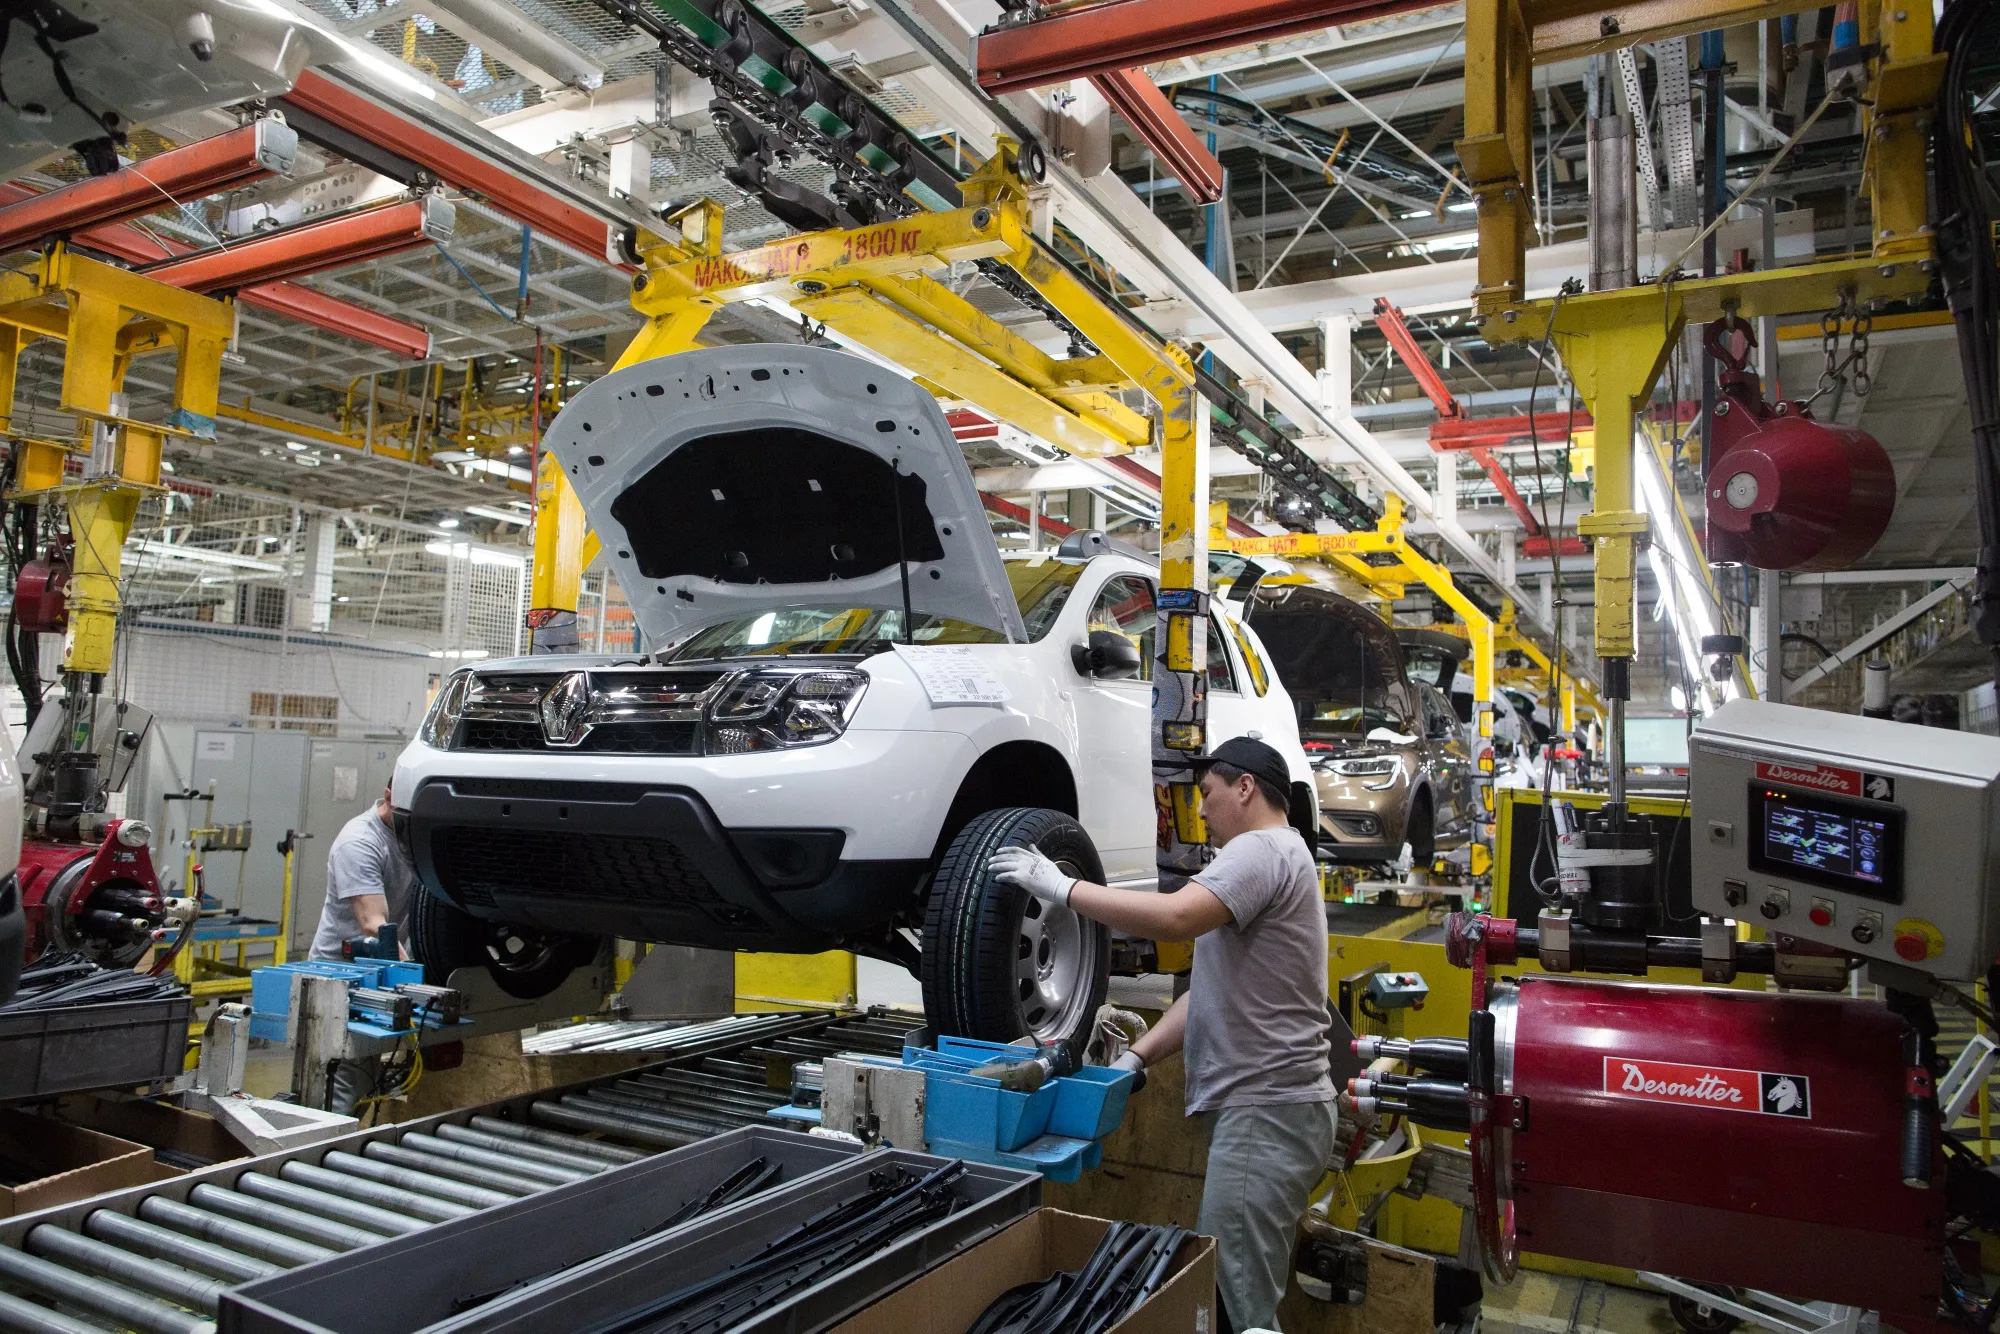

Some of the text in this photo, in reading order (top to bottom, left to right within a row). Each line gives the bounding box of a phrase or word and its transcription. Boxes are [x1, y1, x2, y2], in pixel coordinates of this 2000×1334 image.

[843, 227, 897, 262] 1800
[1316, 536, 1346, 550] 1800
[1766, 764, 1850, 791] Desoutter
[1621, 1062, 1744, 1103] Desoutter
